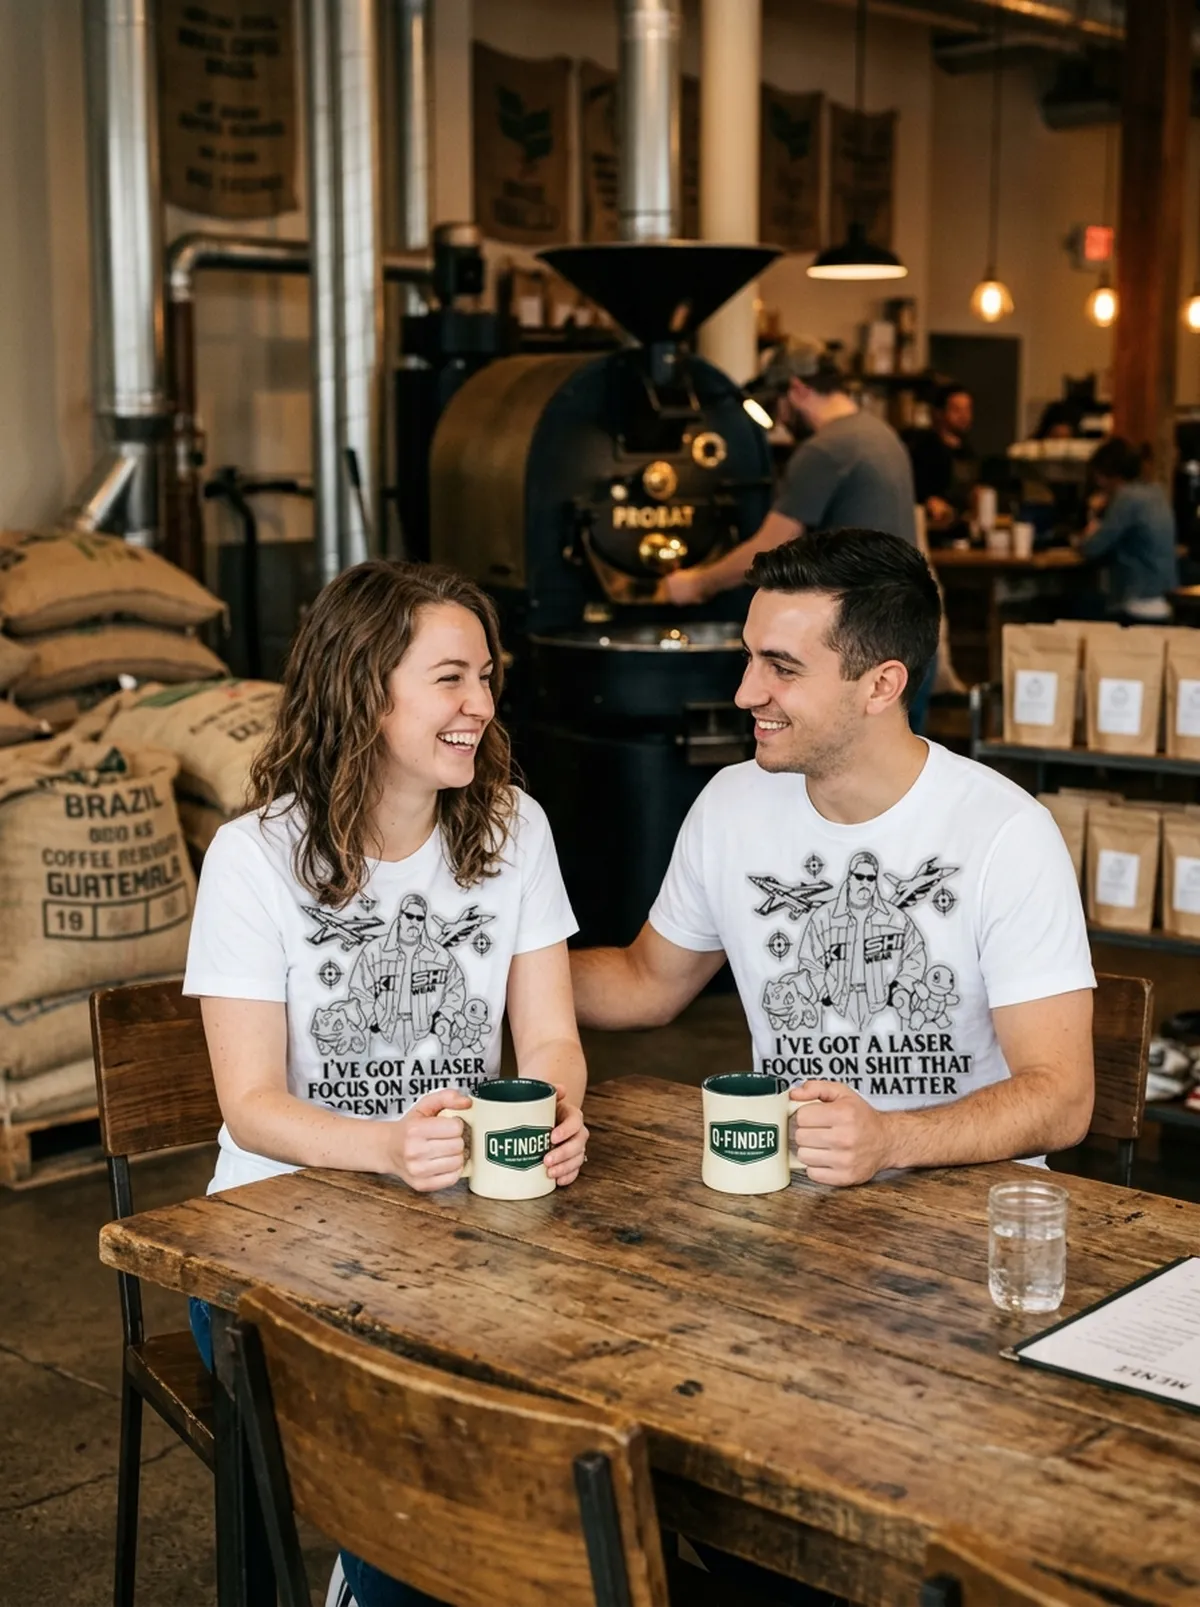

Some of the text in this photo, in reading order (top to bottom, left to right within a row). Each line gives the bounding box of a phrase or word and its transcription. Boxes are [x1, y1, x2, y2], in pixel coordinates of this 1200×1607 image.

[65, 785, 163, 819] BRAZIL
[56, 909, 84, 932] 19
[776, 1034, 954, 1055] I'VE GOT A LASER
[322, 1057, 486, 1079] I'VE GOT A LASER
[762, 1055, 972, 1076] FOCUS ON SHIT THAT
[308, 1081, 369, 1099] FOCUS
[375, 1080, 400, 1097] ON
[870, 1077, 958, 1095] MATTER
